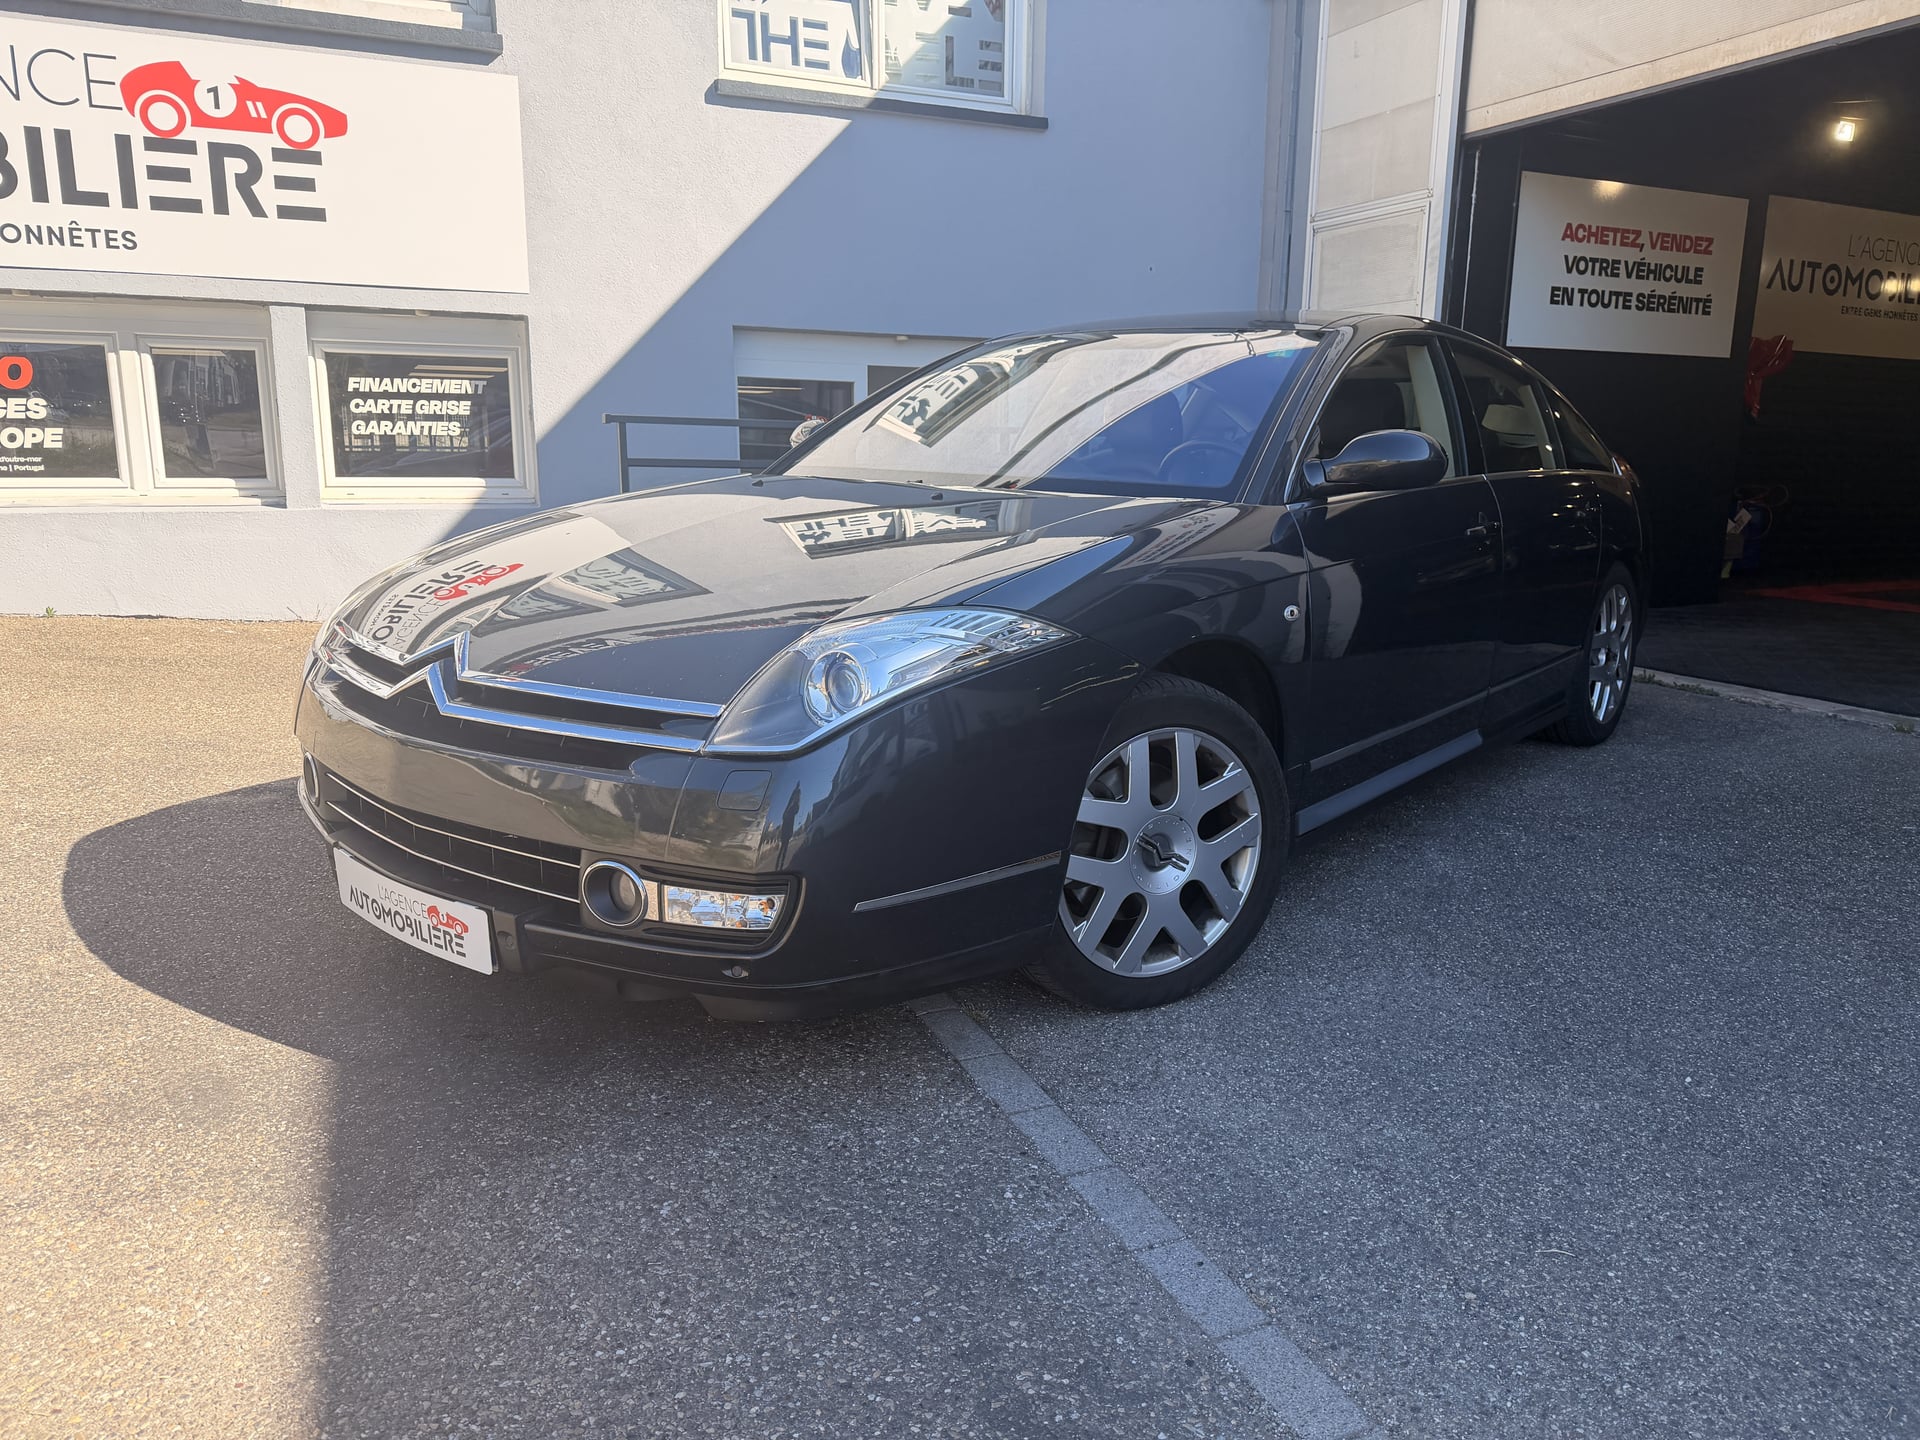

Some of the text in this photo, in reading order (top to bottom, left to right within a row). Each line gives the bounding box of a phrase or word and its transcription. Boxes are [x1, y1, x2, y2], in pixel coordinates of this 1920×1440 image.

[0, 219, 138, 251] ONNÊTES
[1561, 222, 1715, 256] ACHETEZ, VENDEZ
[1847, 233, 1920, 267] L'AGENC
[1563, 254, 1705, 286] VOTRE VÉHICULE
[1549, 286, 1713, 317] EN TOUTE SÉRÉNITÉ
[1864, 307, 1882, 318] GENS
[347, 376, 488, 395] FINANCEMENT
[349, 398, 472, 416] CARTE GRISE
[377, 883, 429, 920] L'AGENCE
